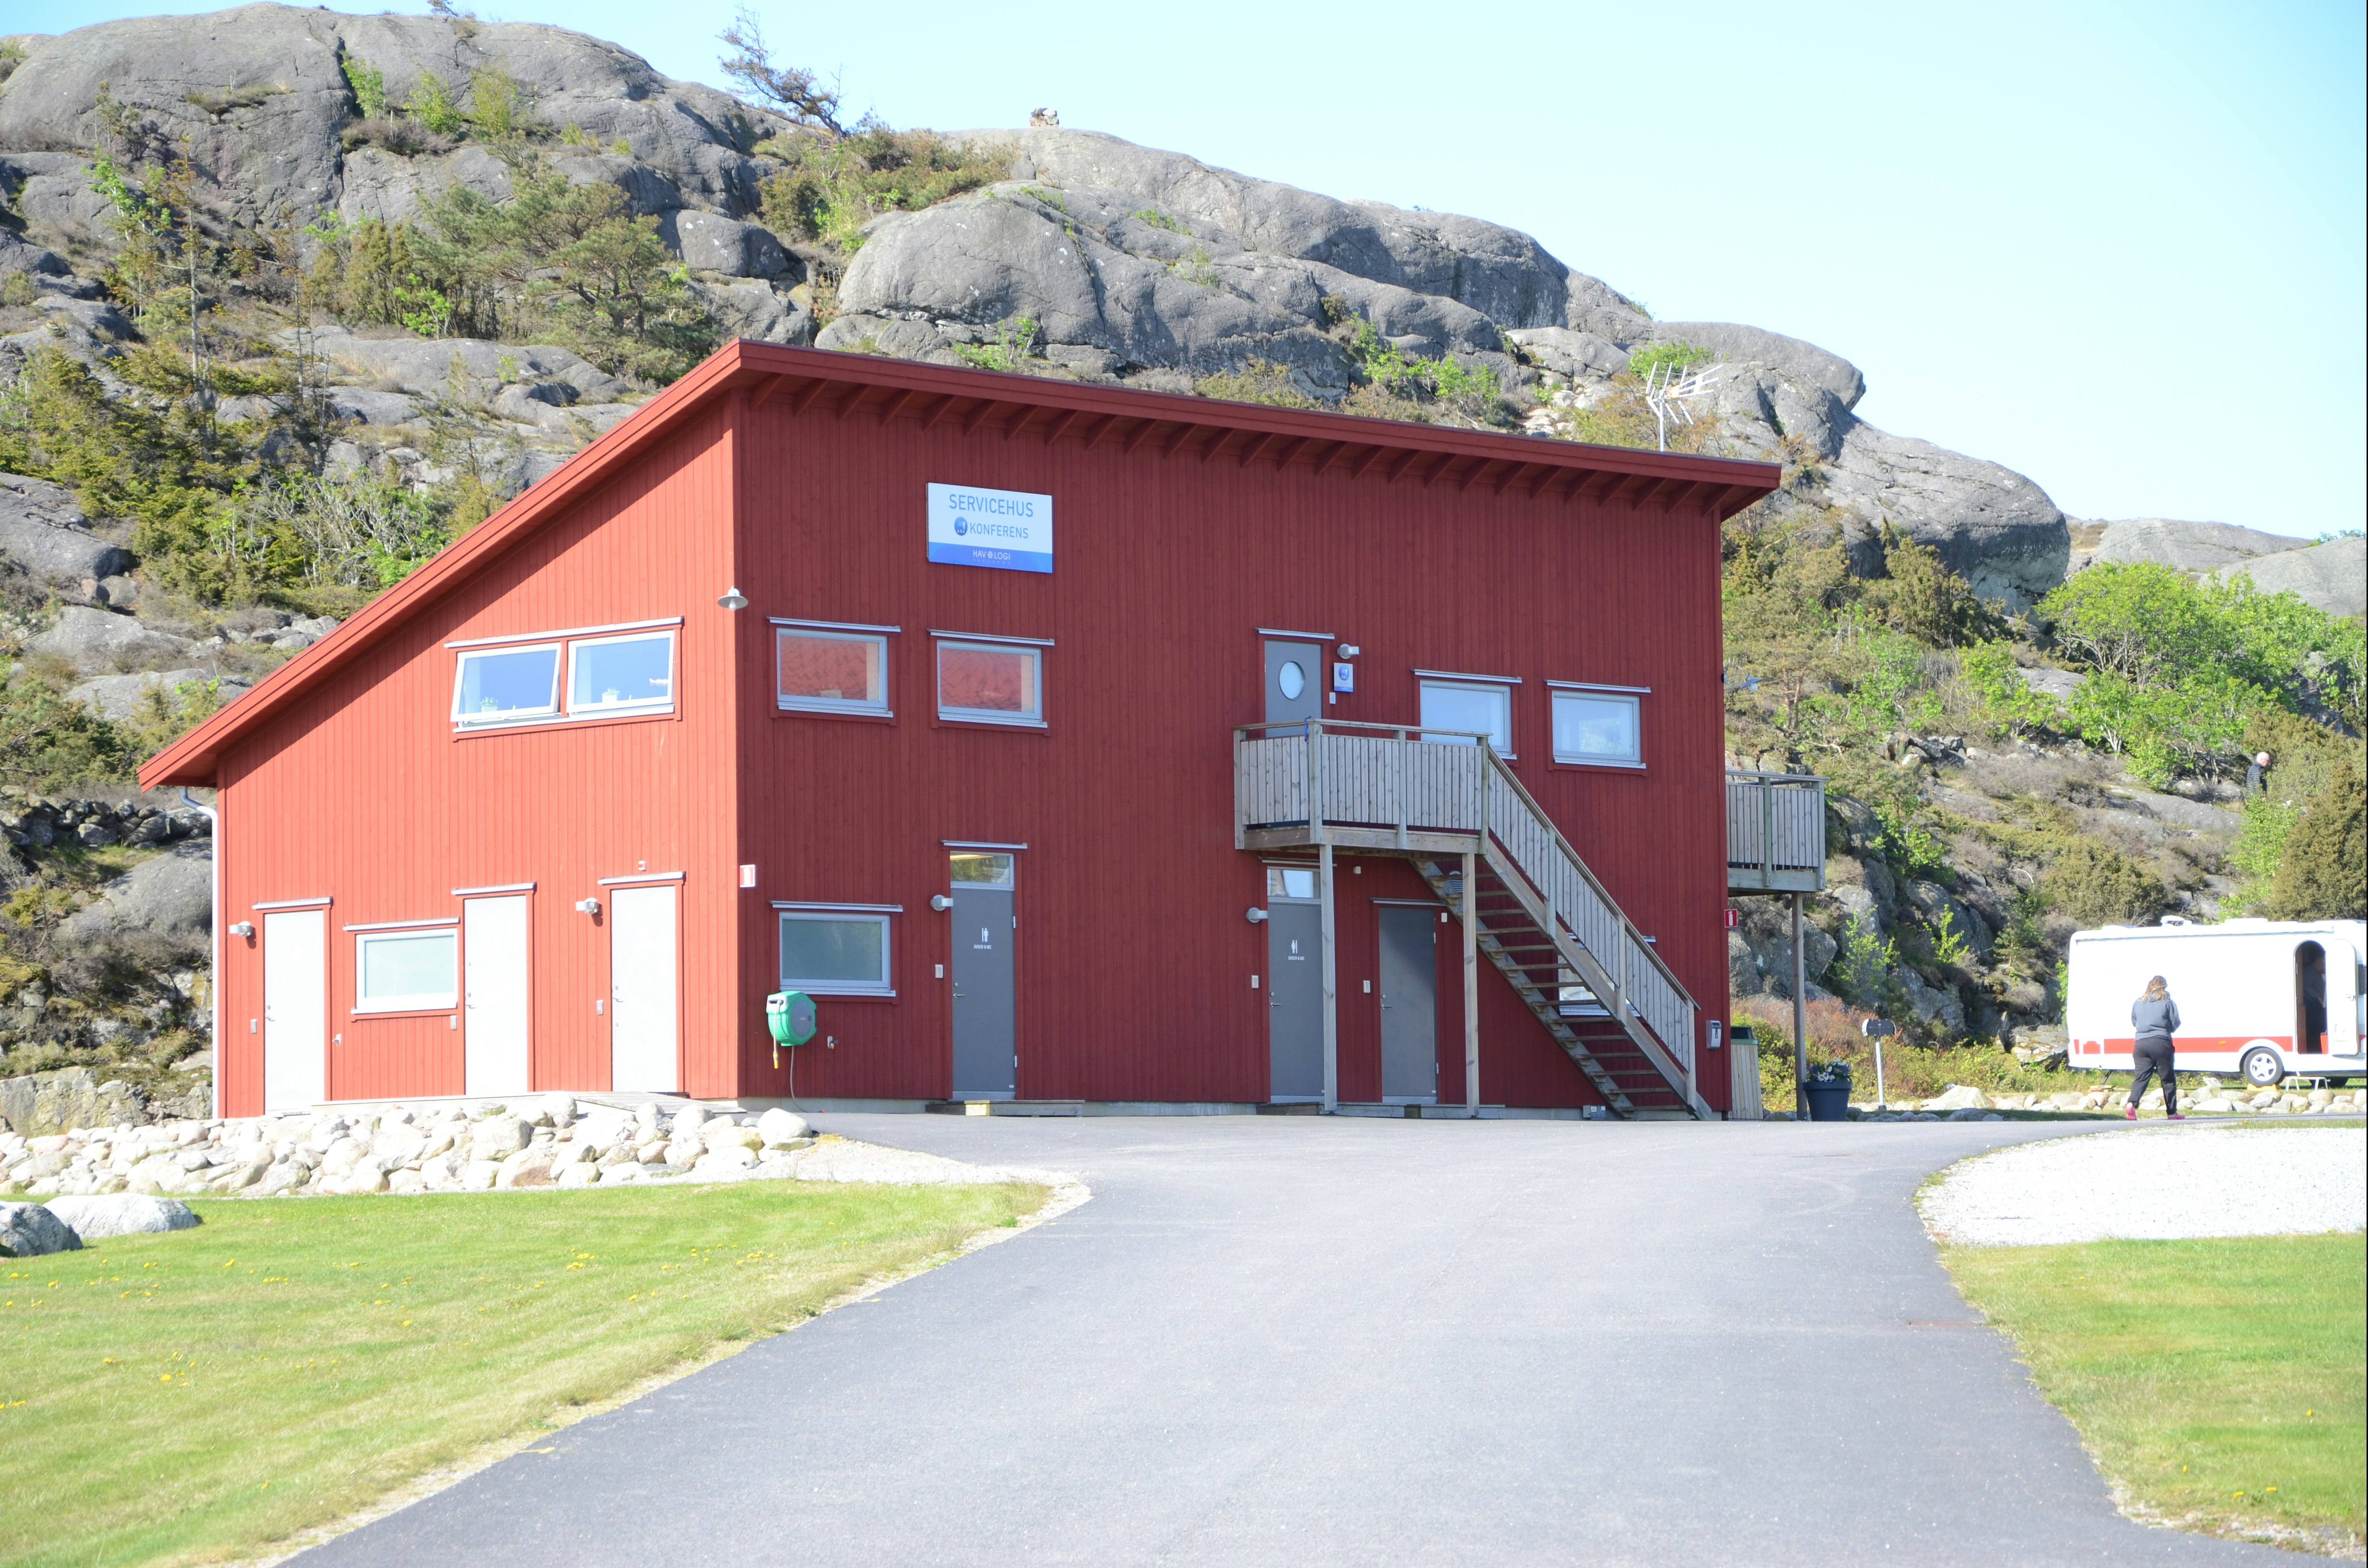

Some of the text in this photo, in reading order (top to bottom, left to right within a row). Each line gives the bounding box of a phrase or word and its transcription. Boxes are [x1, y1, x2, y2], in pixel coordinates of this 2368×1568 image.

[949, 493, 1033, 517] SERVICEHUS
[970, 522, 1028, 539] KONFERENS
[973, 550, 1010, 560] HAV LOGI
